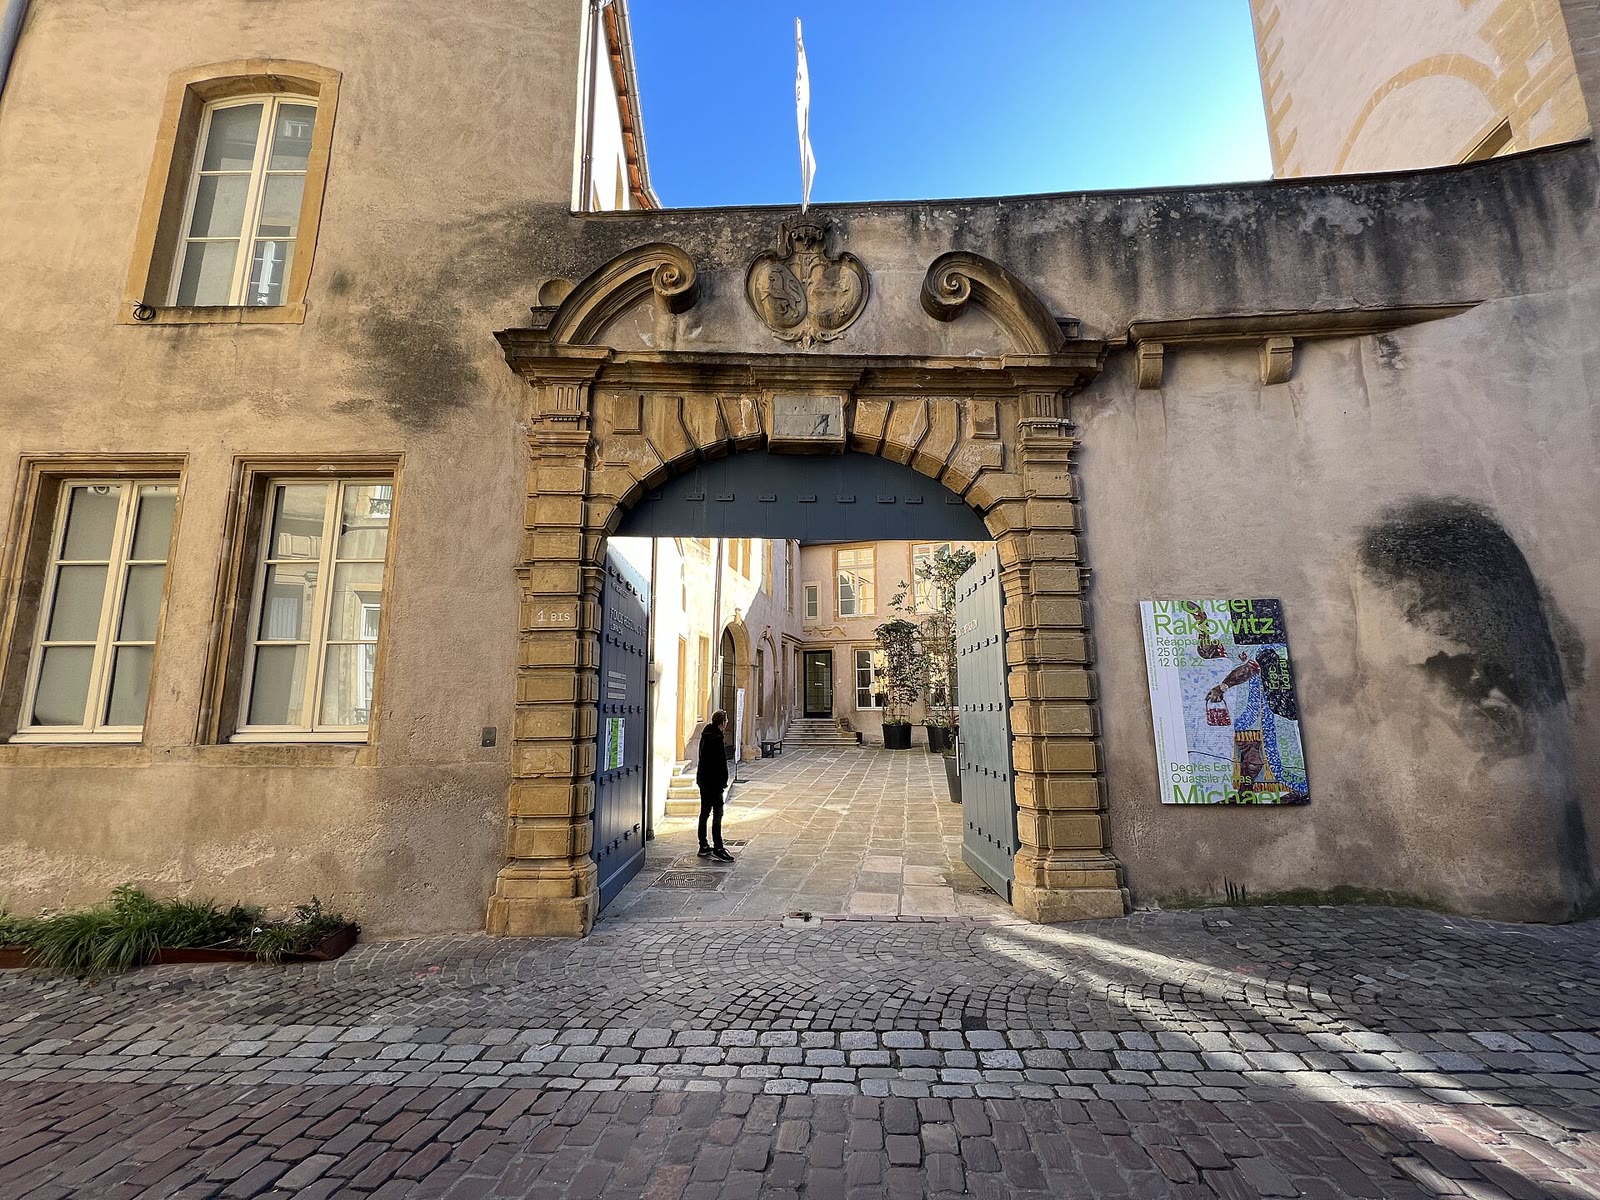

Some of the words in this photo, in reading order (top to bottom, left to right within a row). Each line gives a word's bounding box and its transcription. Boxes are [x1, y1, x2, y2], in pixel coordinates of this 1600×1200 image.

[537, 609, 546, 622] 1
[1153, 613, 1276, 636] Rakowitz
[1157, 648, 1171, 657] 25
[1171, 648, 1185, 657] 02
[1159, 658, 1170, 667] 12
[1173, 658, 1187, 667] 06
[1190, 657, 1204, 667] 22
[1268, 665, 1280, 690] Frac
[1170, 762, 1211, 774] Degrés
[1214, 763, 1232, 772] Est
[1171, 773, 1220, 784] Ouassila
[1172, 784, 1281, 804] Michael
